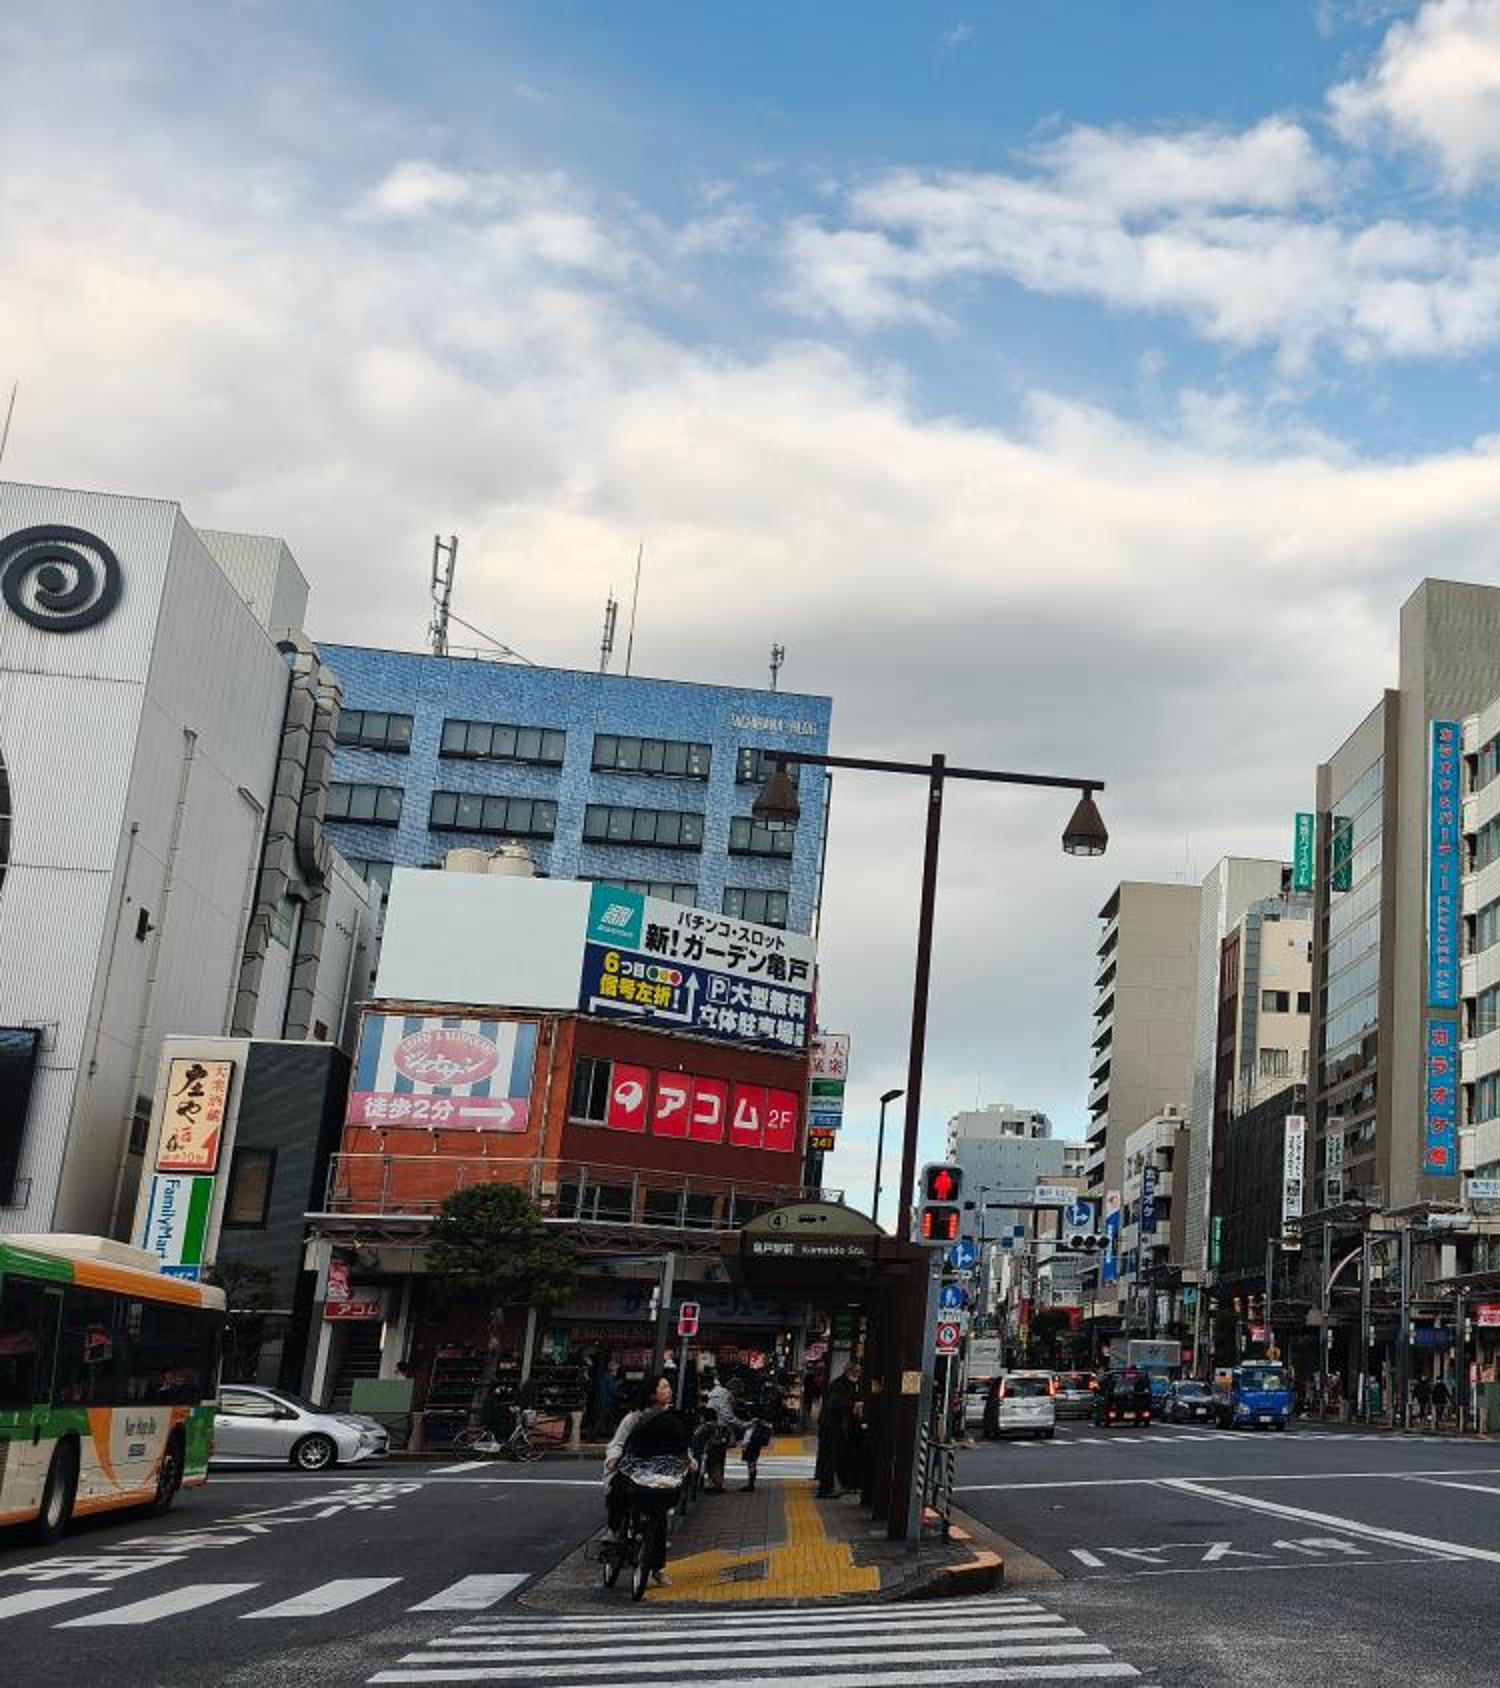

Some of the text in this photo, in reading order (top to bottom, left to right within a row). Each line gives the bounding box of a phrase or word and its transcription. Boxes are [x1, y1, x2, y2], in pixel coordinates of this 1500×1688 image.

[364, 1097, 454, 1121] 徒歩2分
[656, 1086, 760, 1131] アコム
[768, 1109, 793, 1130] 2F
[155, 1179, 181, 1260] FamilyMart
